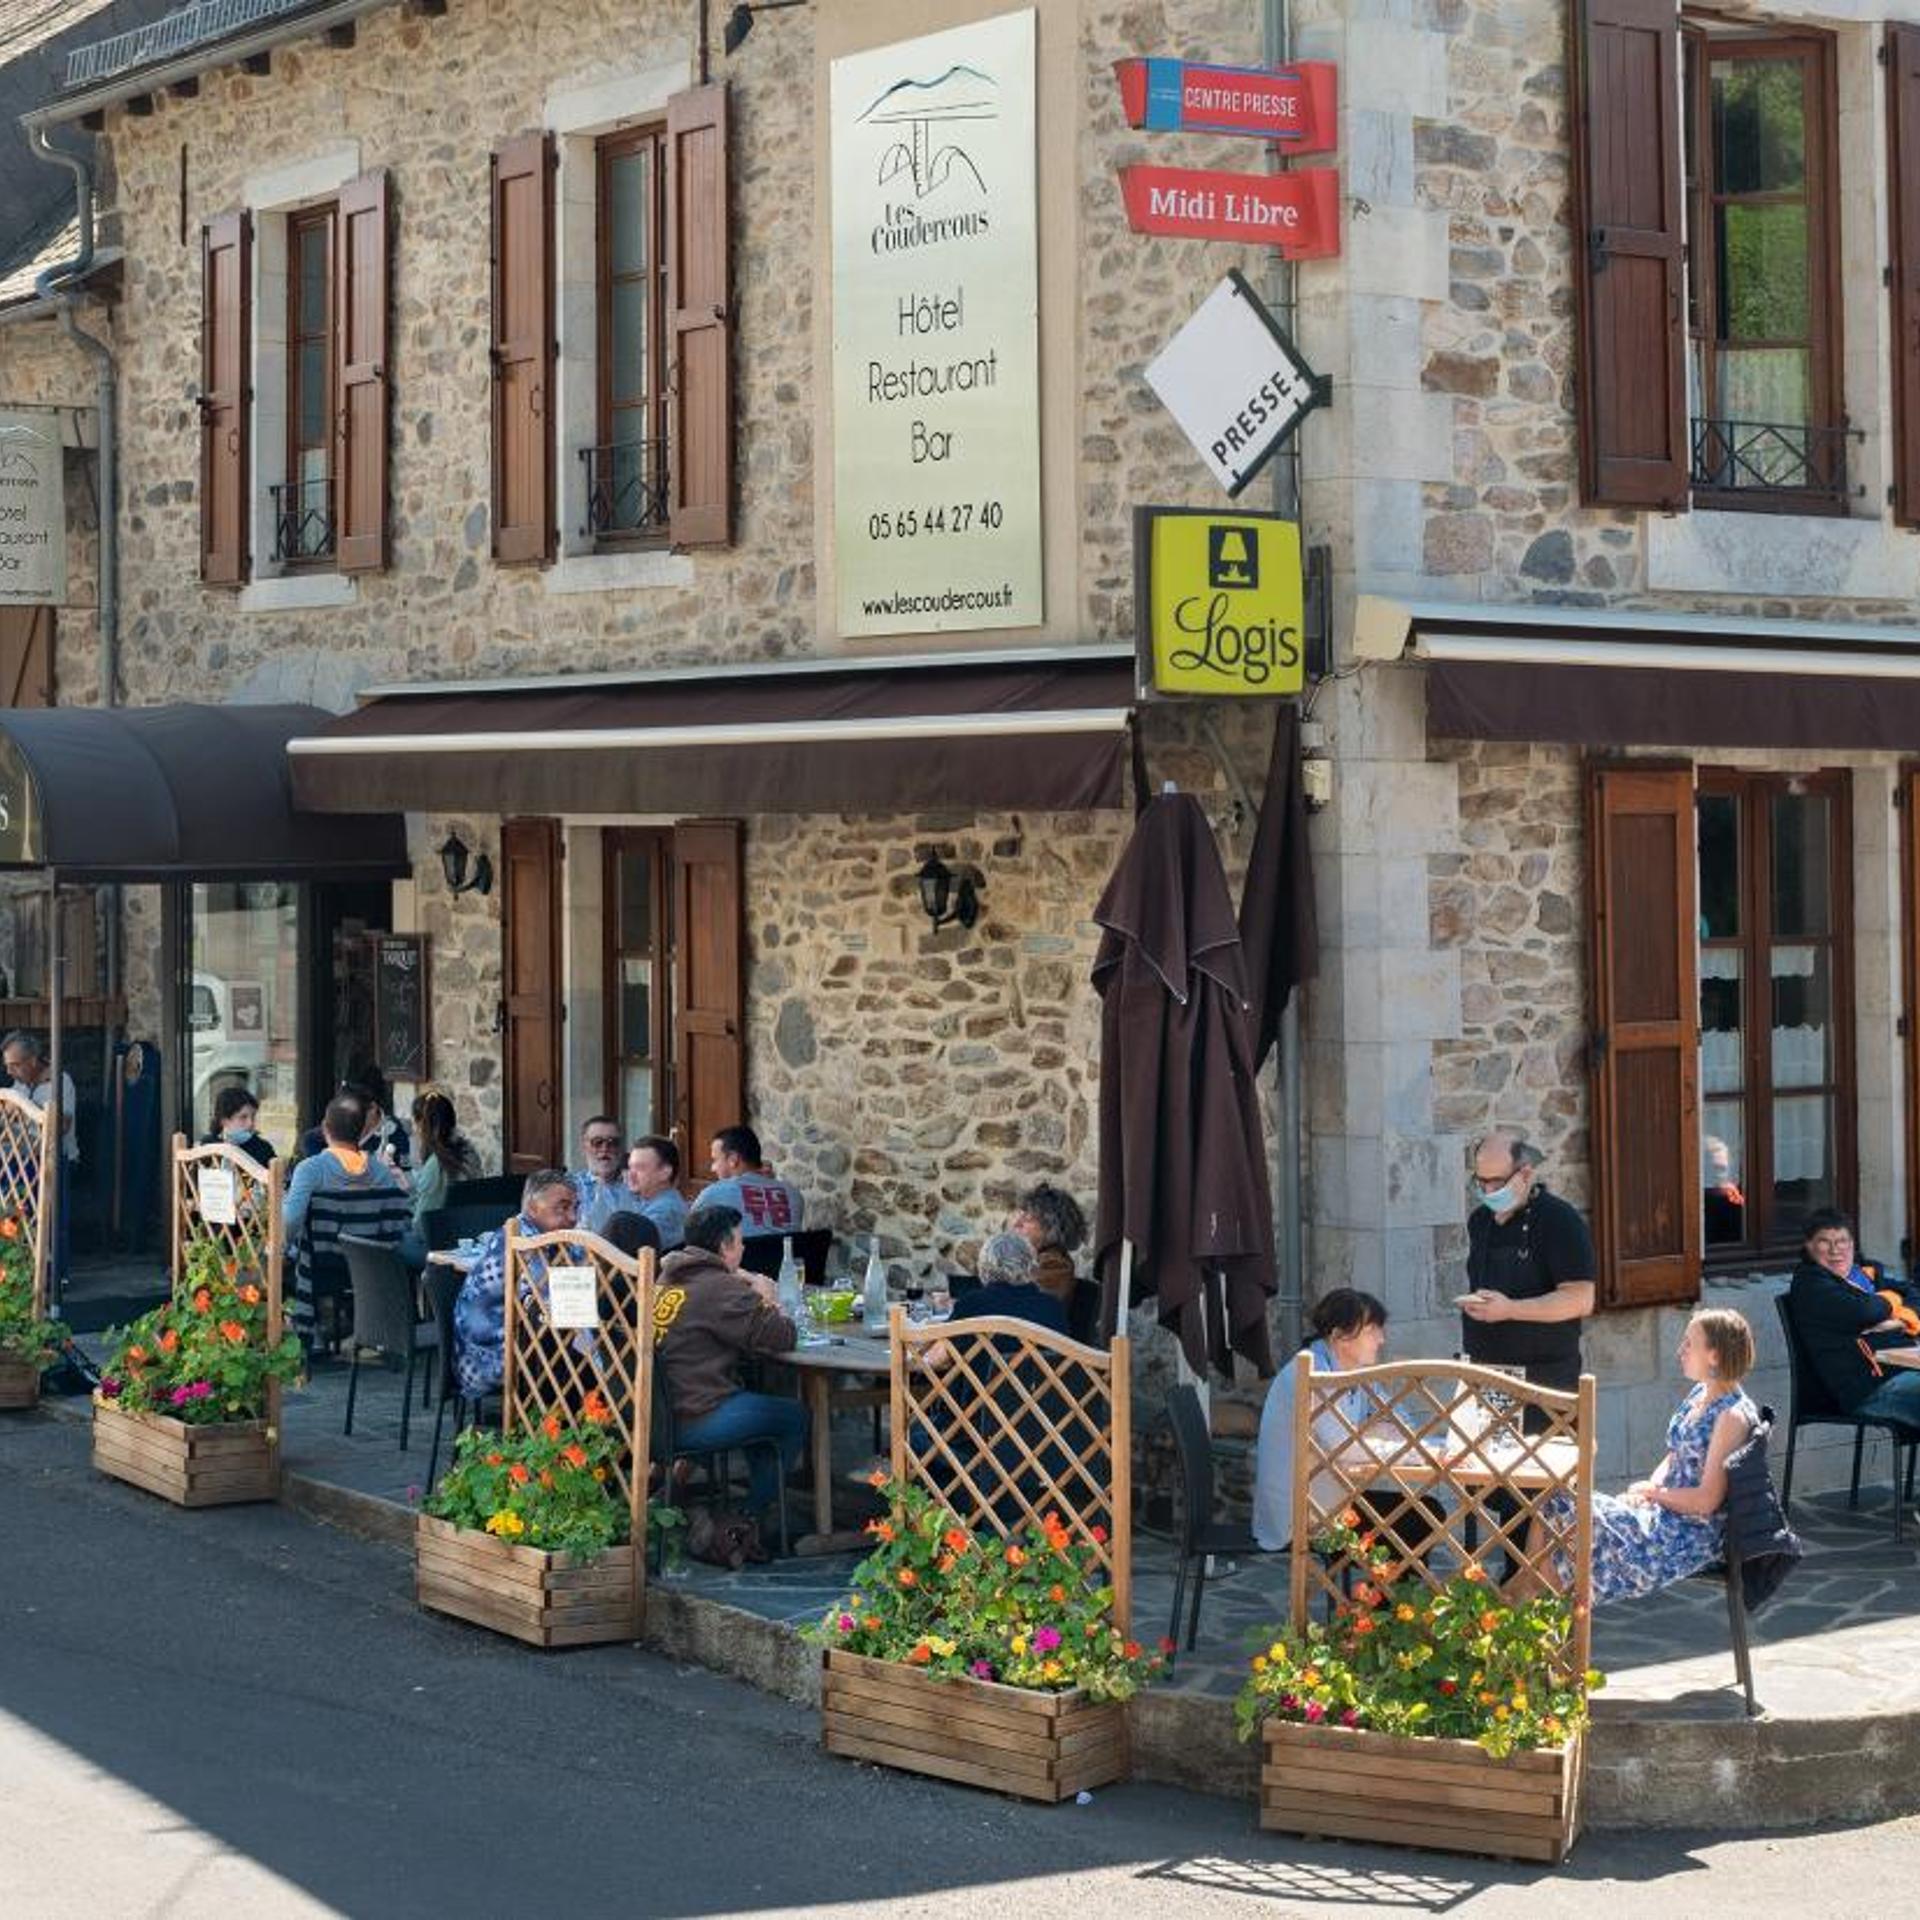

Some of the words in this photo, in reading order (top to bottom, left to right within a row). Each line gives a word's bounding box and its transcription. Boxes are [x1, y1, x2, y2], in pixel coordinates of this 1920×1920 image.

[1185, 87, 1241, 112] CENTRE
[1243, 94, 1297, 117] PRESSE
[885, 203, 915, 226] Les
[1150, 187, 1215, 220] Midi
[1224, 194, 1299, 227] Libre
[871, 211, 989, 254] Coudercous
[899, 286, 964, 335] Hôtel
[869, 348, 997, 404] Restaurant
[1211, 370, 1292, 467] PRESSE
[911, 420, 953, 464] Bar
[869, 512, 891, 540] 05
[896, 510, 917, 538] 65
[923, 507, 945, 535] 44
[952, 504, 973, 532] 27
[980, 501, 1003, 529] 40
[863, 583, 1012, 616] www.lescoudercous.fr
[1169, 592, 1299, 685] Logis
